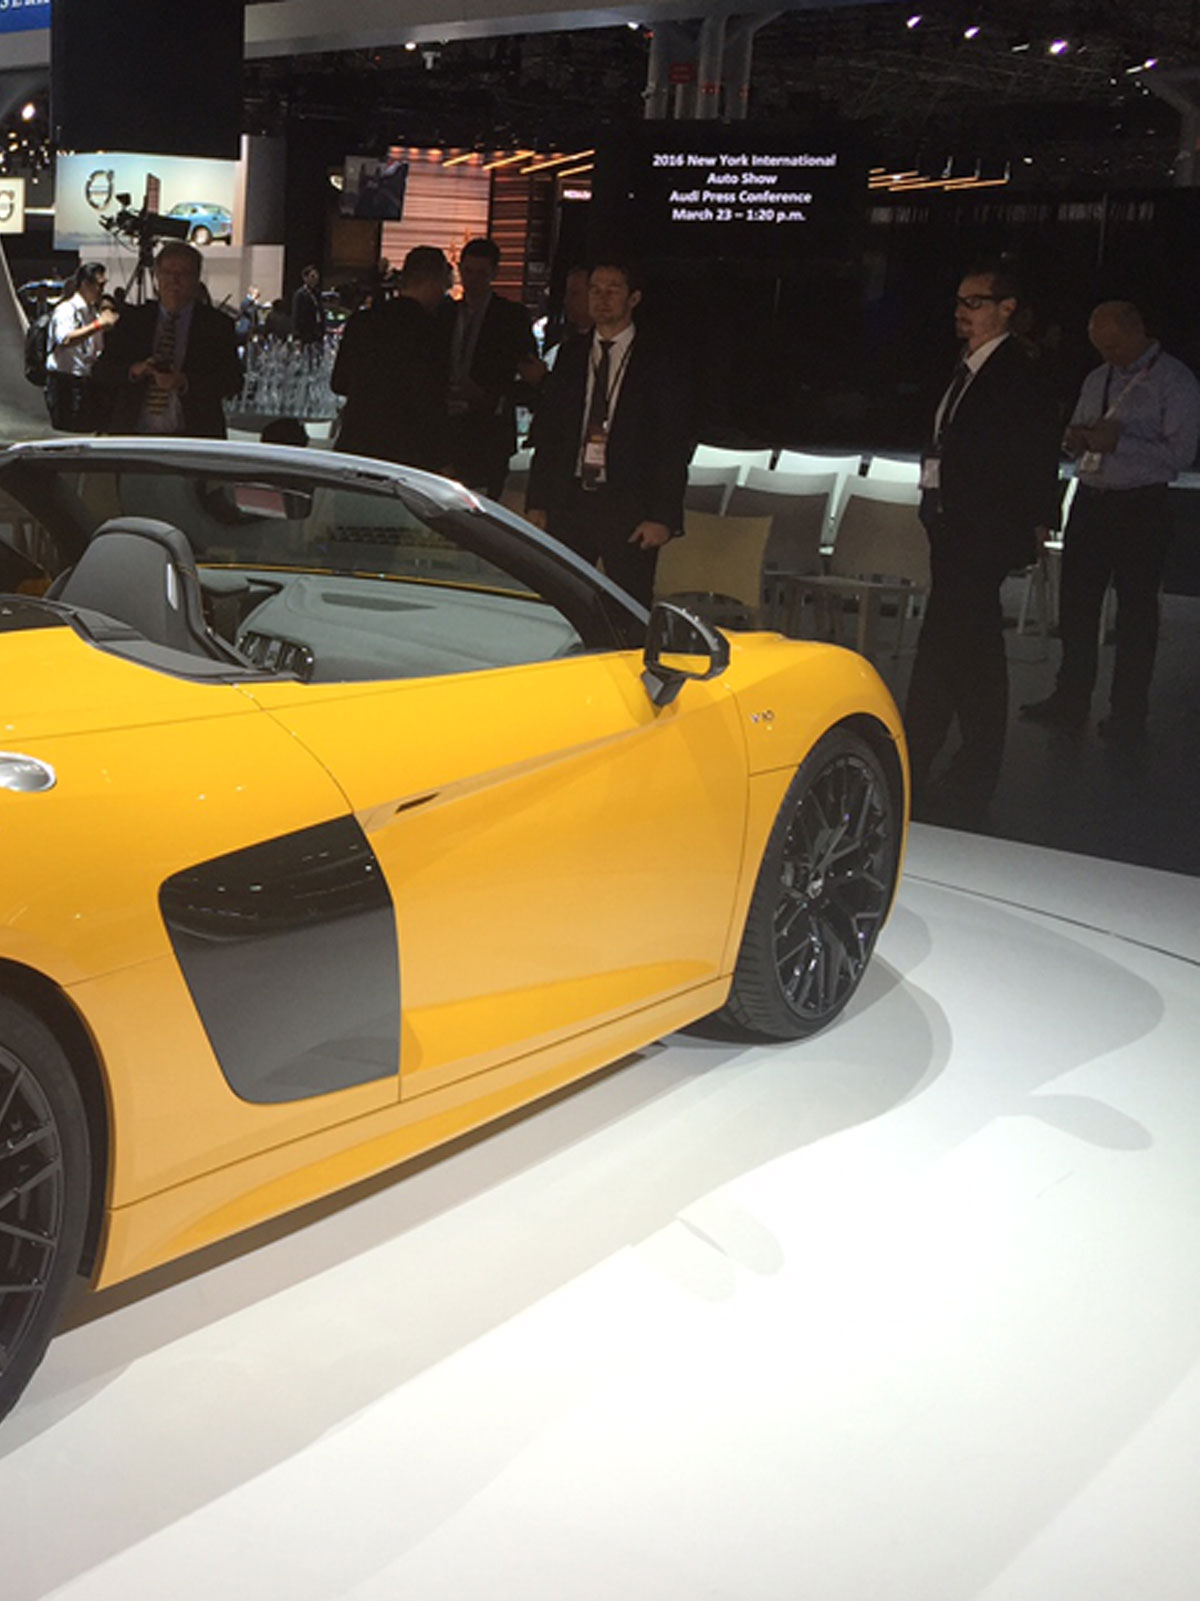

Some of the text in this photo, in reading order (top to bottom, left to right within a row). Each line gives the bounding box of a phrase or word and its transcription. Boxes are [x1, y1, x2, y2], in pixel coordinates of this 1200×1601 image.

[653, 154, 837, 167] 2016 New York International
[707, 172, 777, 184] Auto Show
[669, 190, 812, 203] Audi Press Conference
[672, 208, 713, 221] March
[716, 208, 732, 221] 23
[746, 208, 774, 221] 1:20
[777, 210, 805, 223] p.m.
